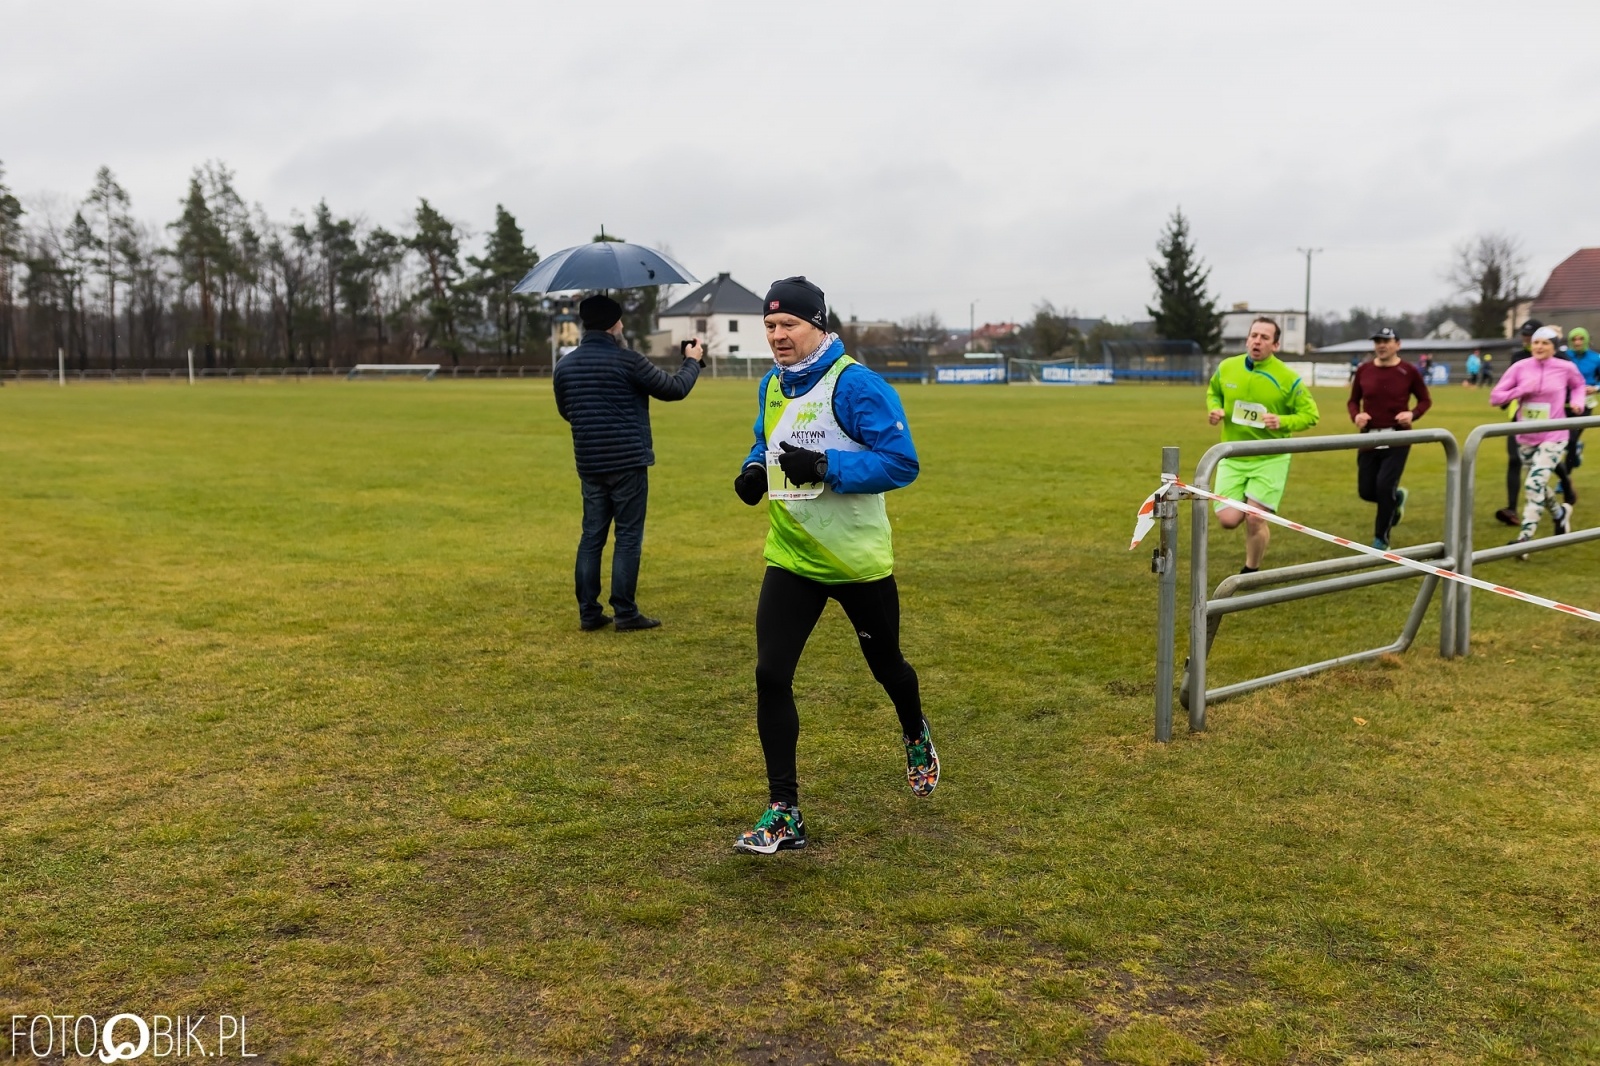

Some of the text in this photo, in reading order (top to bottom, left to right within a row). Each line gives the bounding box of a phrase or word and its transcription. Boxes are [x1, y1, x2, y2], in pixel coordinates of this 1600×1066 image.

[1243, 409, 1258, 422] 79
[1527, 409, 1541, 419] 57
[790, 430, 826, 439] AKTYWNI
